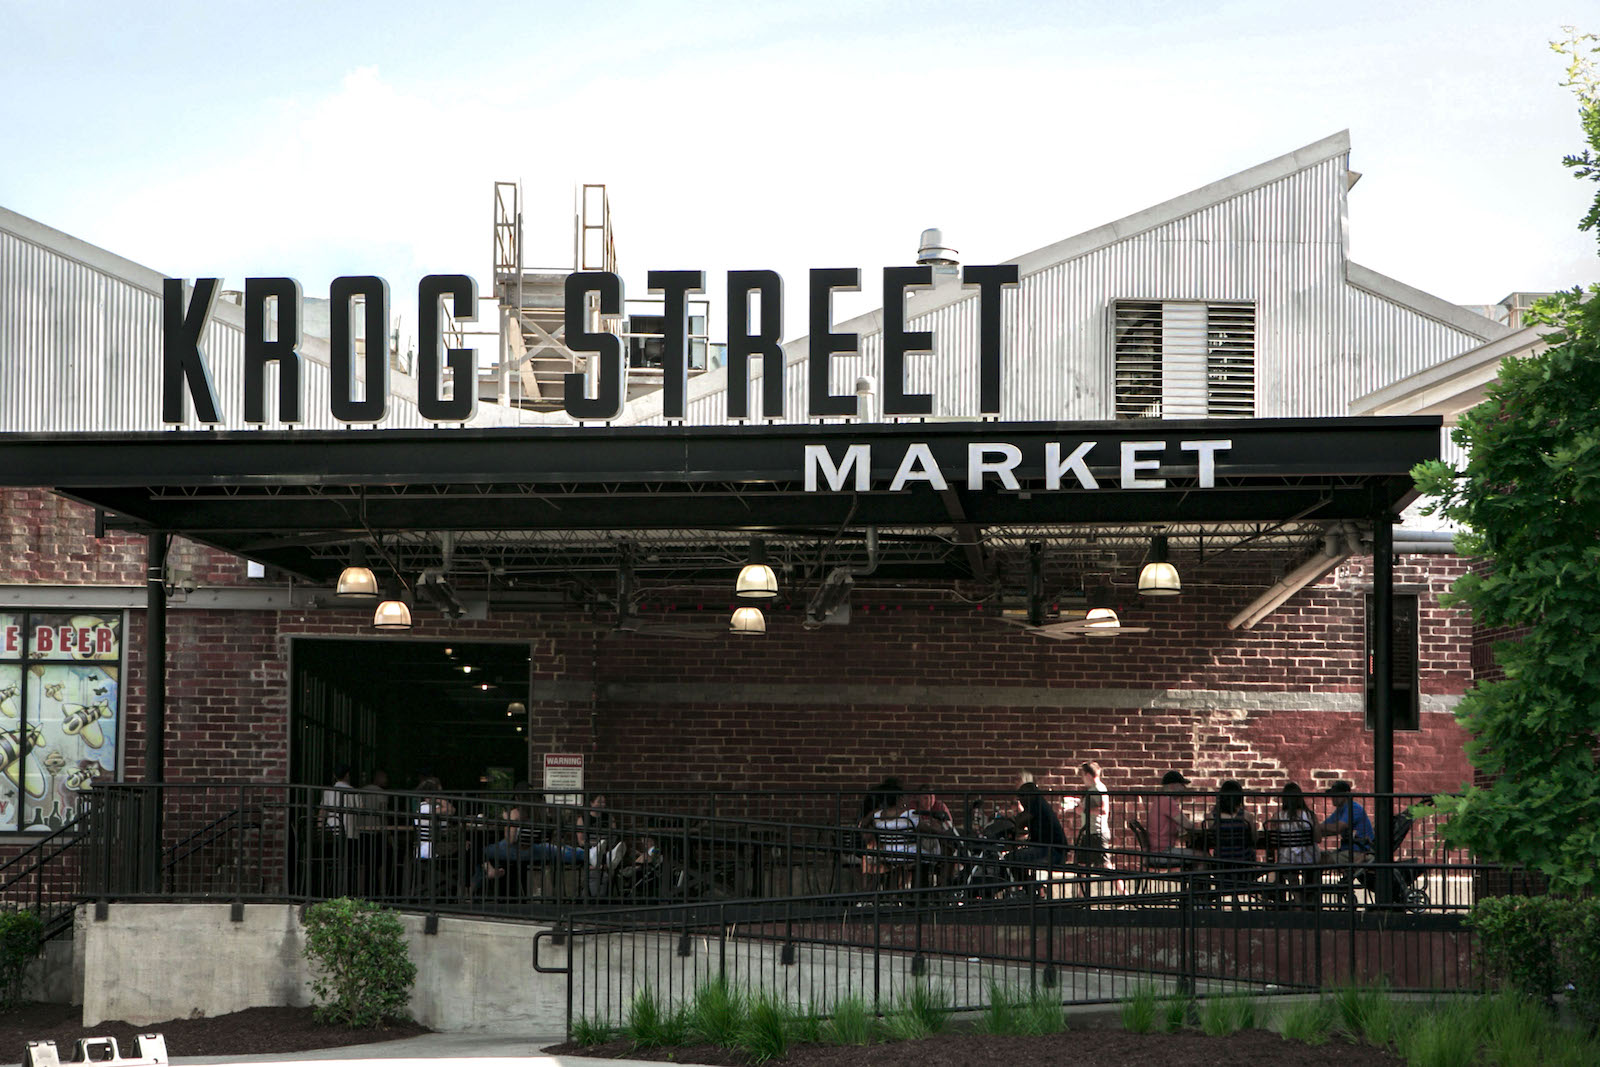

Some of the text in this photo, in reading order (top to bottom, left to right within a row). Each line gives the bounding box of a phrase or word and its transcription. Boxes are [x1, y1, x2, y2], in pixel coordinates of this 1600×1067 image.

[163, 265, 1021, 424] KROG STREET
[804, 440, 1232, 491] MARKET
[36, 626, 113, 653] BEER
[547, 757, 582, 765] WARNING
